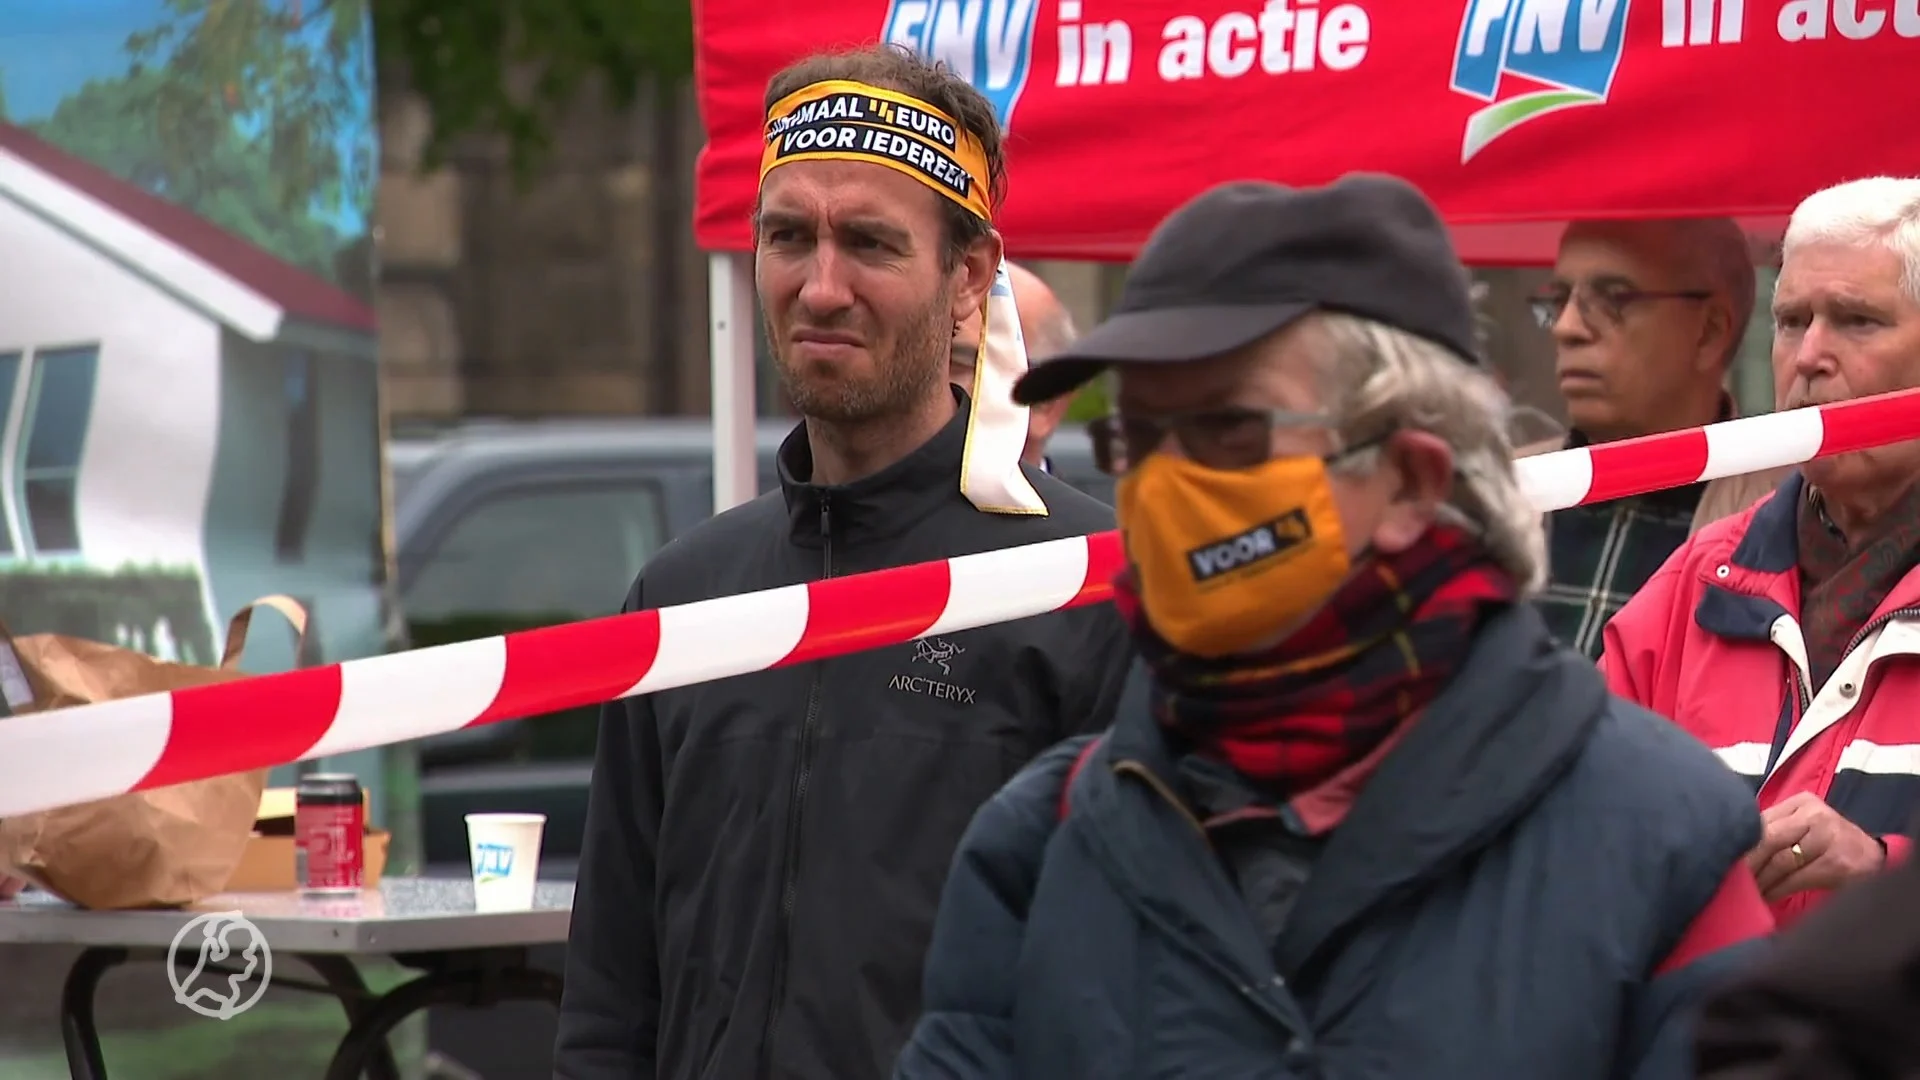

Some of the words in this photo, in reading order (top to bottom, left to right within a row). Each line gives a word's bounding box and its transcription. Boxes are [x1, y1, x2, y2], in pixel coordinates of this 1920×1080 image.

[1056, 3, 1132, 87] in
[1158, 0, 1370, 82] actie
[896, 106, 955, 145] EURO
[784, 126, 857, 152] VOOR
[862, 129, 972, 191] IEDEREEN
[1193, 527, 1276, 575] VOOR
[888, 674, 976, 704] ARC'TERYX
